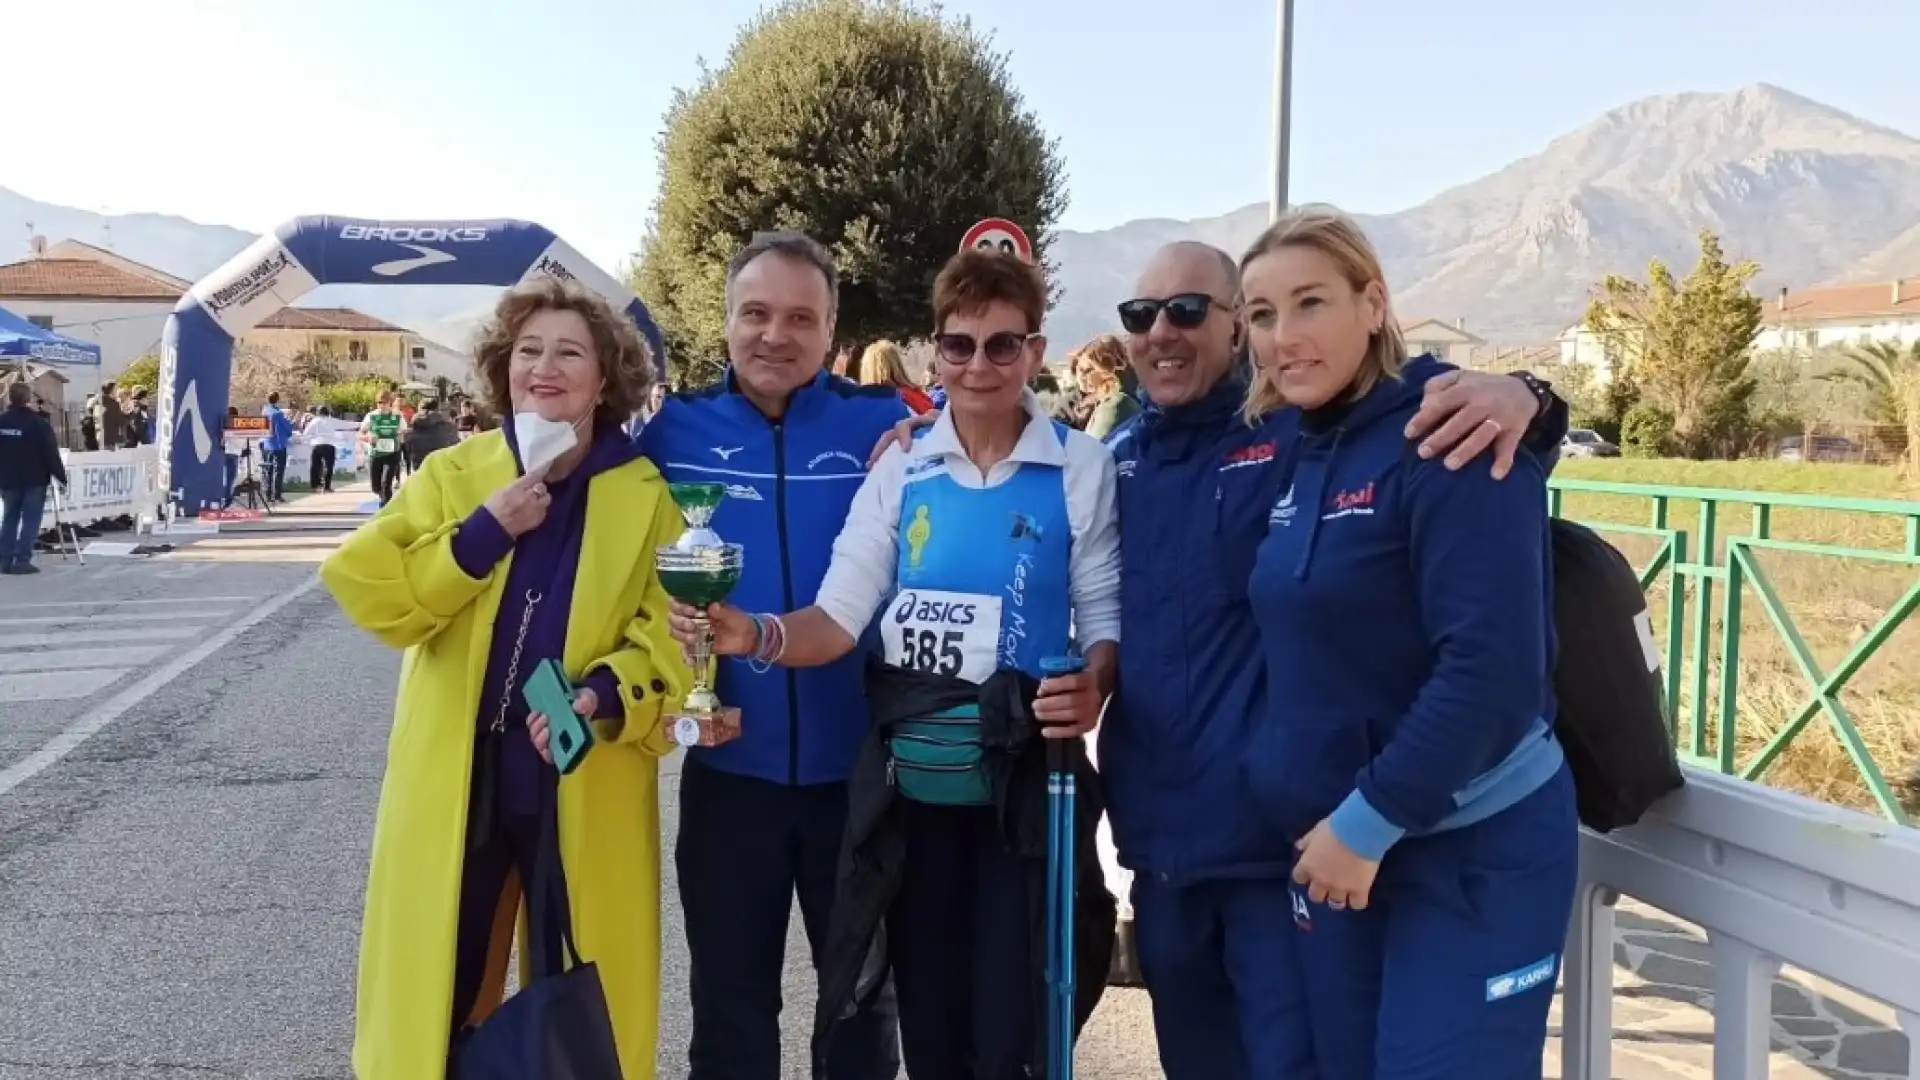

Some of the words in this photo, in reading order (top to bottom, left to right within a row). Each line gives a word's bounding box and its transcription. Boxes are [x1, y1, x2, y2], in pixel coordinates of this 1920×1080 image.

[340, 224, 486, 242] BROOKS
[1005, 553, 1034, 607] Keep
[916, 601, 976, 625] asics
[901, 627, 964, 678] 585
